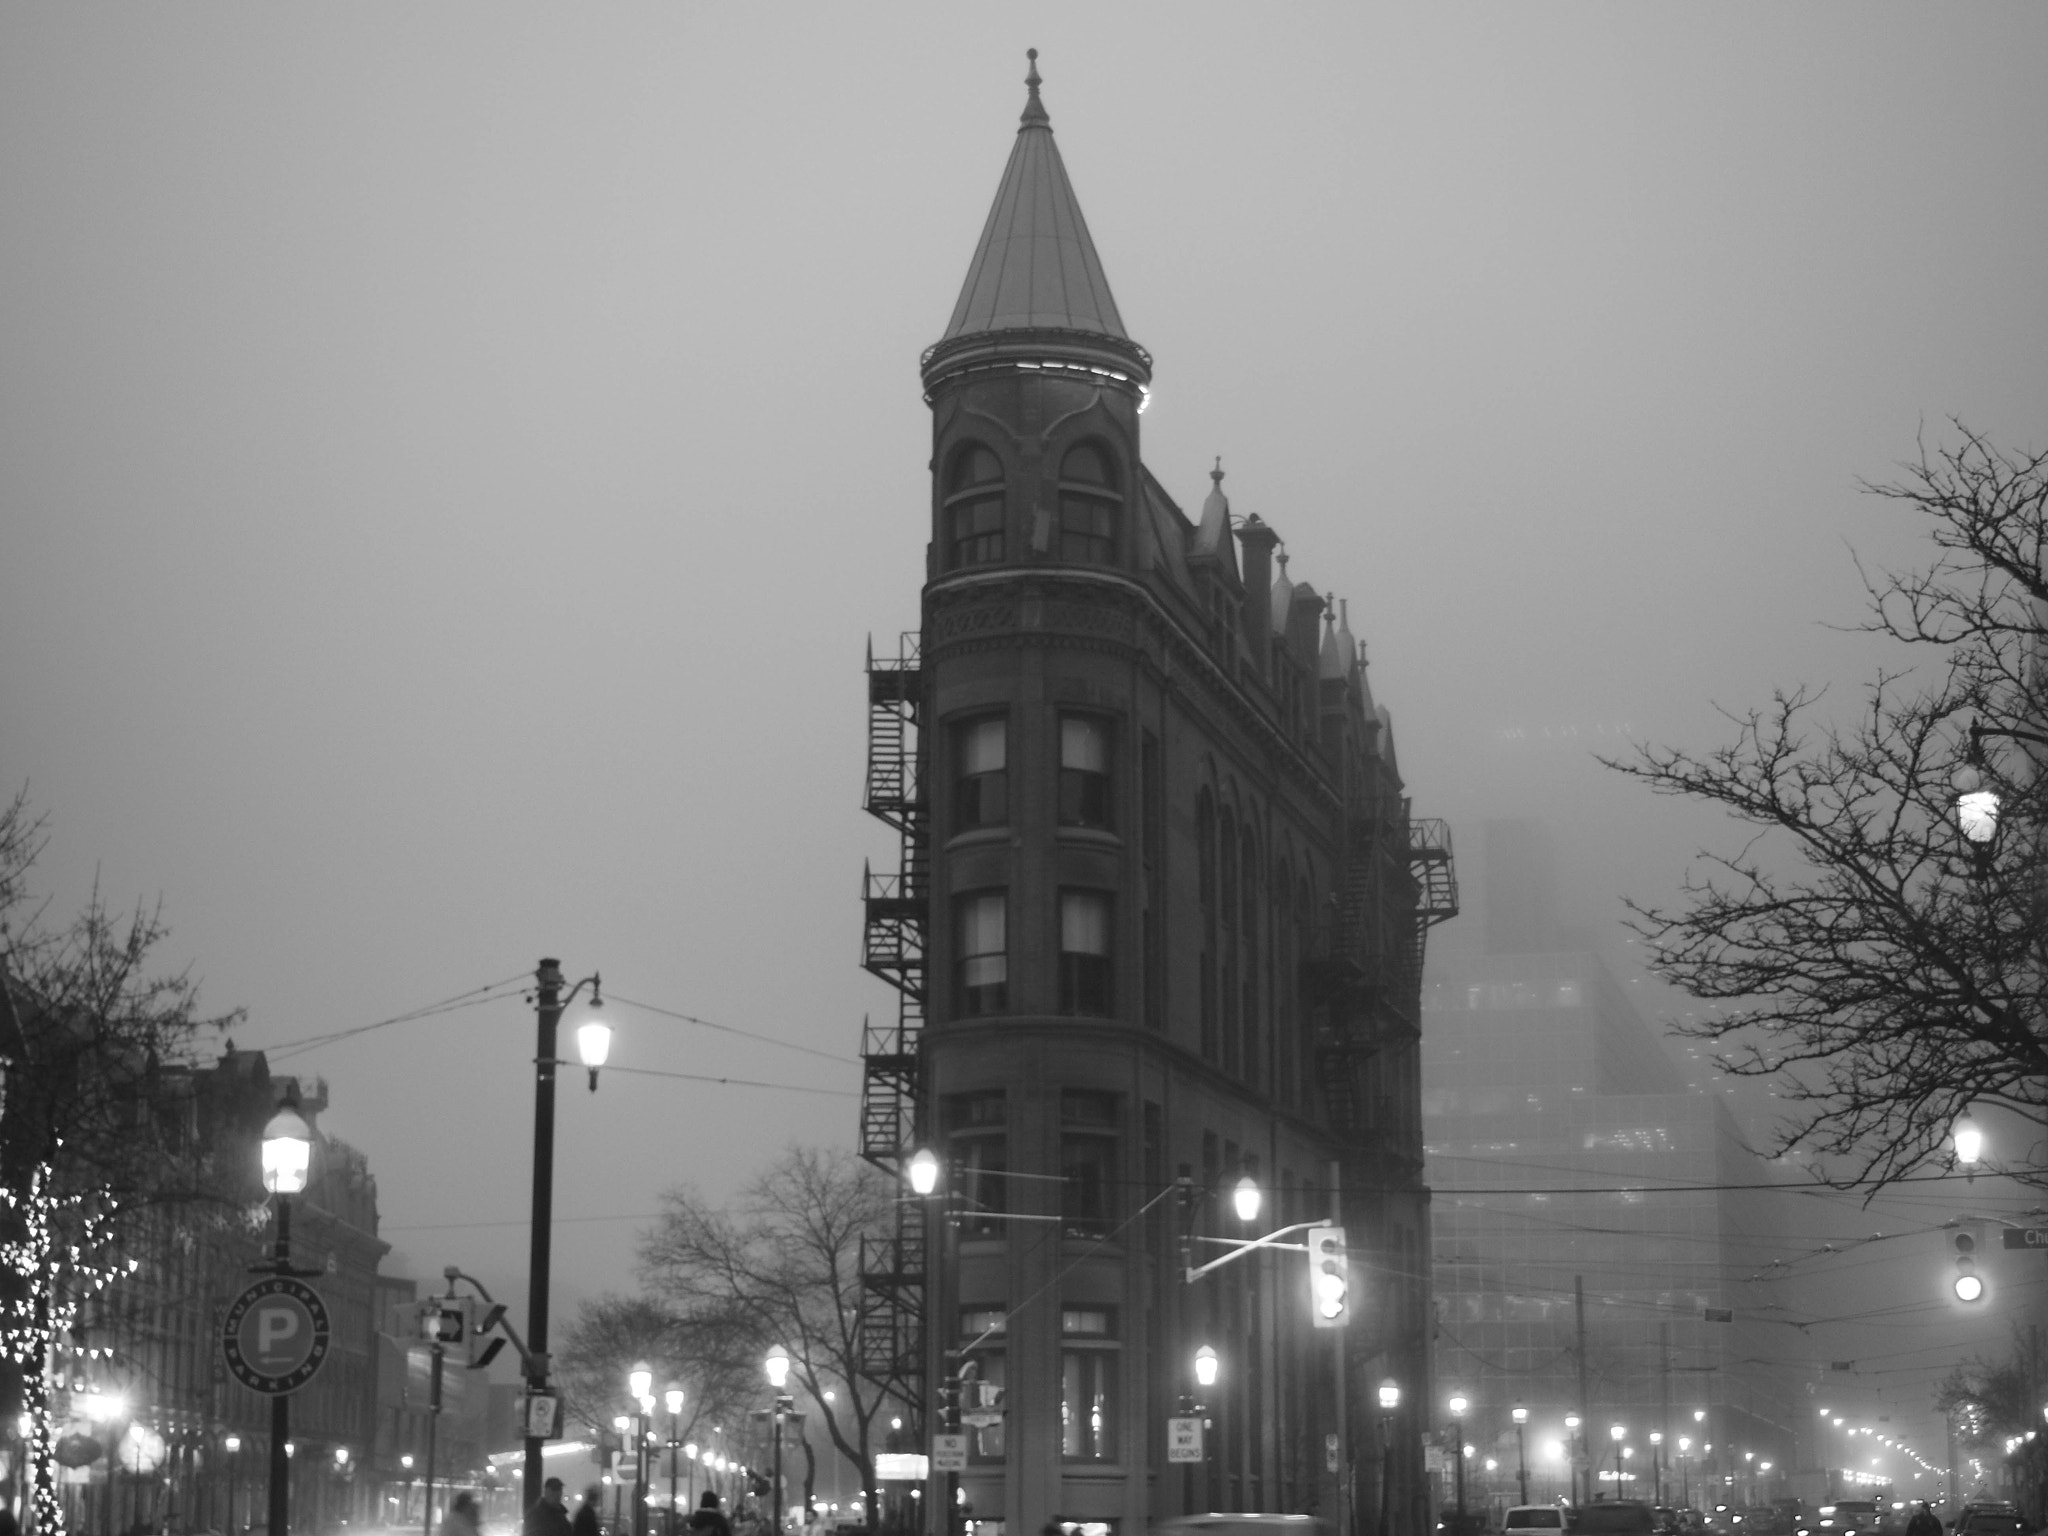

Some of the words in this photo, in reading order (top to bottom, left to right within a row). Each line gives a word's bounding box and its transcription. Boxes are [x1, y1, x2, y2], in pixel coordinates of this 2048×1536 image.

[228, 1281, 325, 1333] MUNICIPAL
[259, 1308, 299, 1353] P
[228, 1345, 323, 1390] PARKING
[1176, 1421, 1193, 1432] ONE
[944, 1438, 957, 1449] NO
[1177, 1435, 1192, 1445] WAY
[1168, 1447, 1201, 1458] BEGINS
